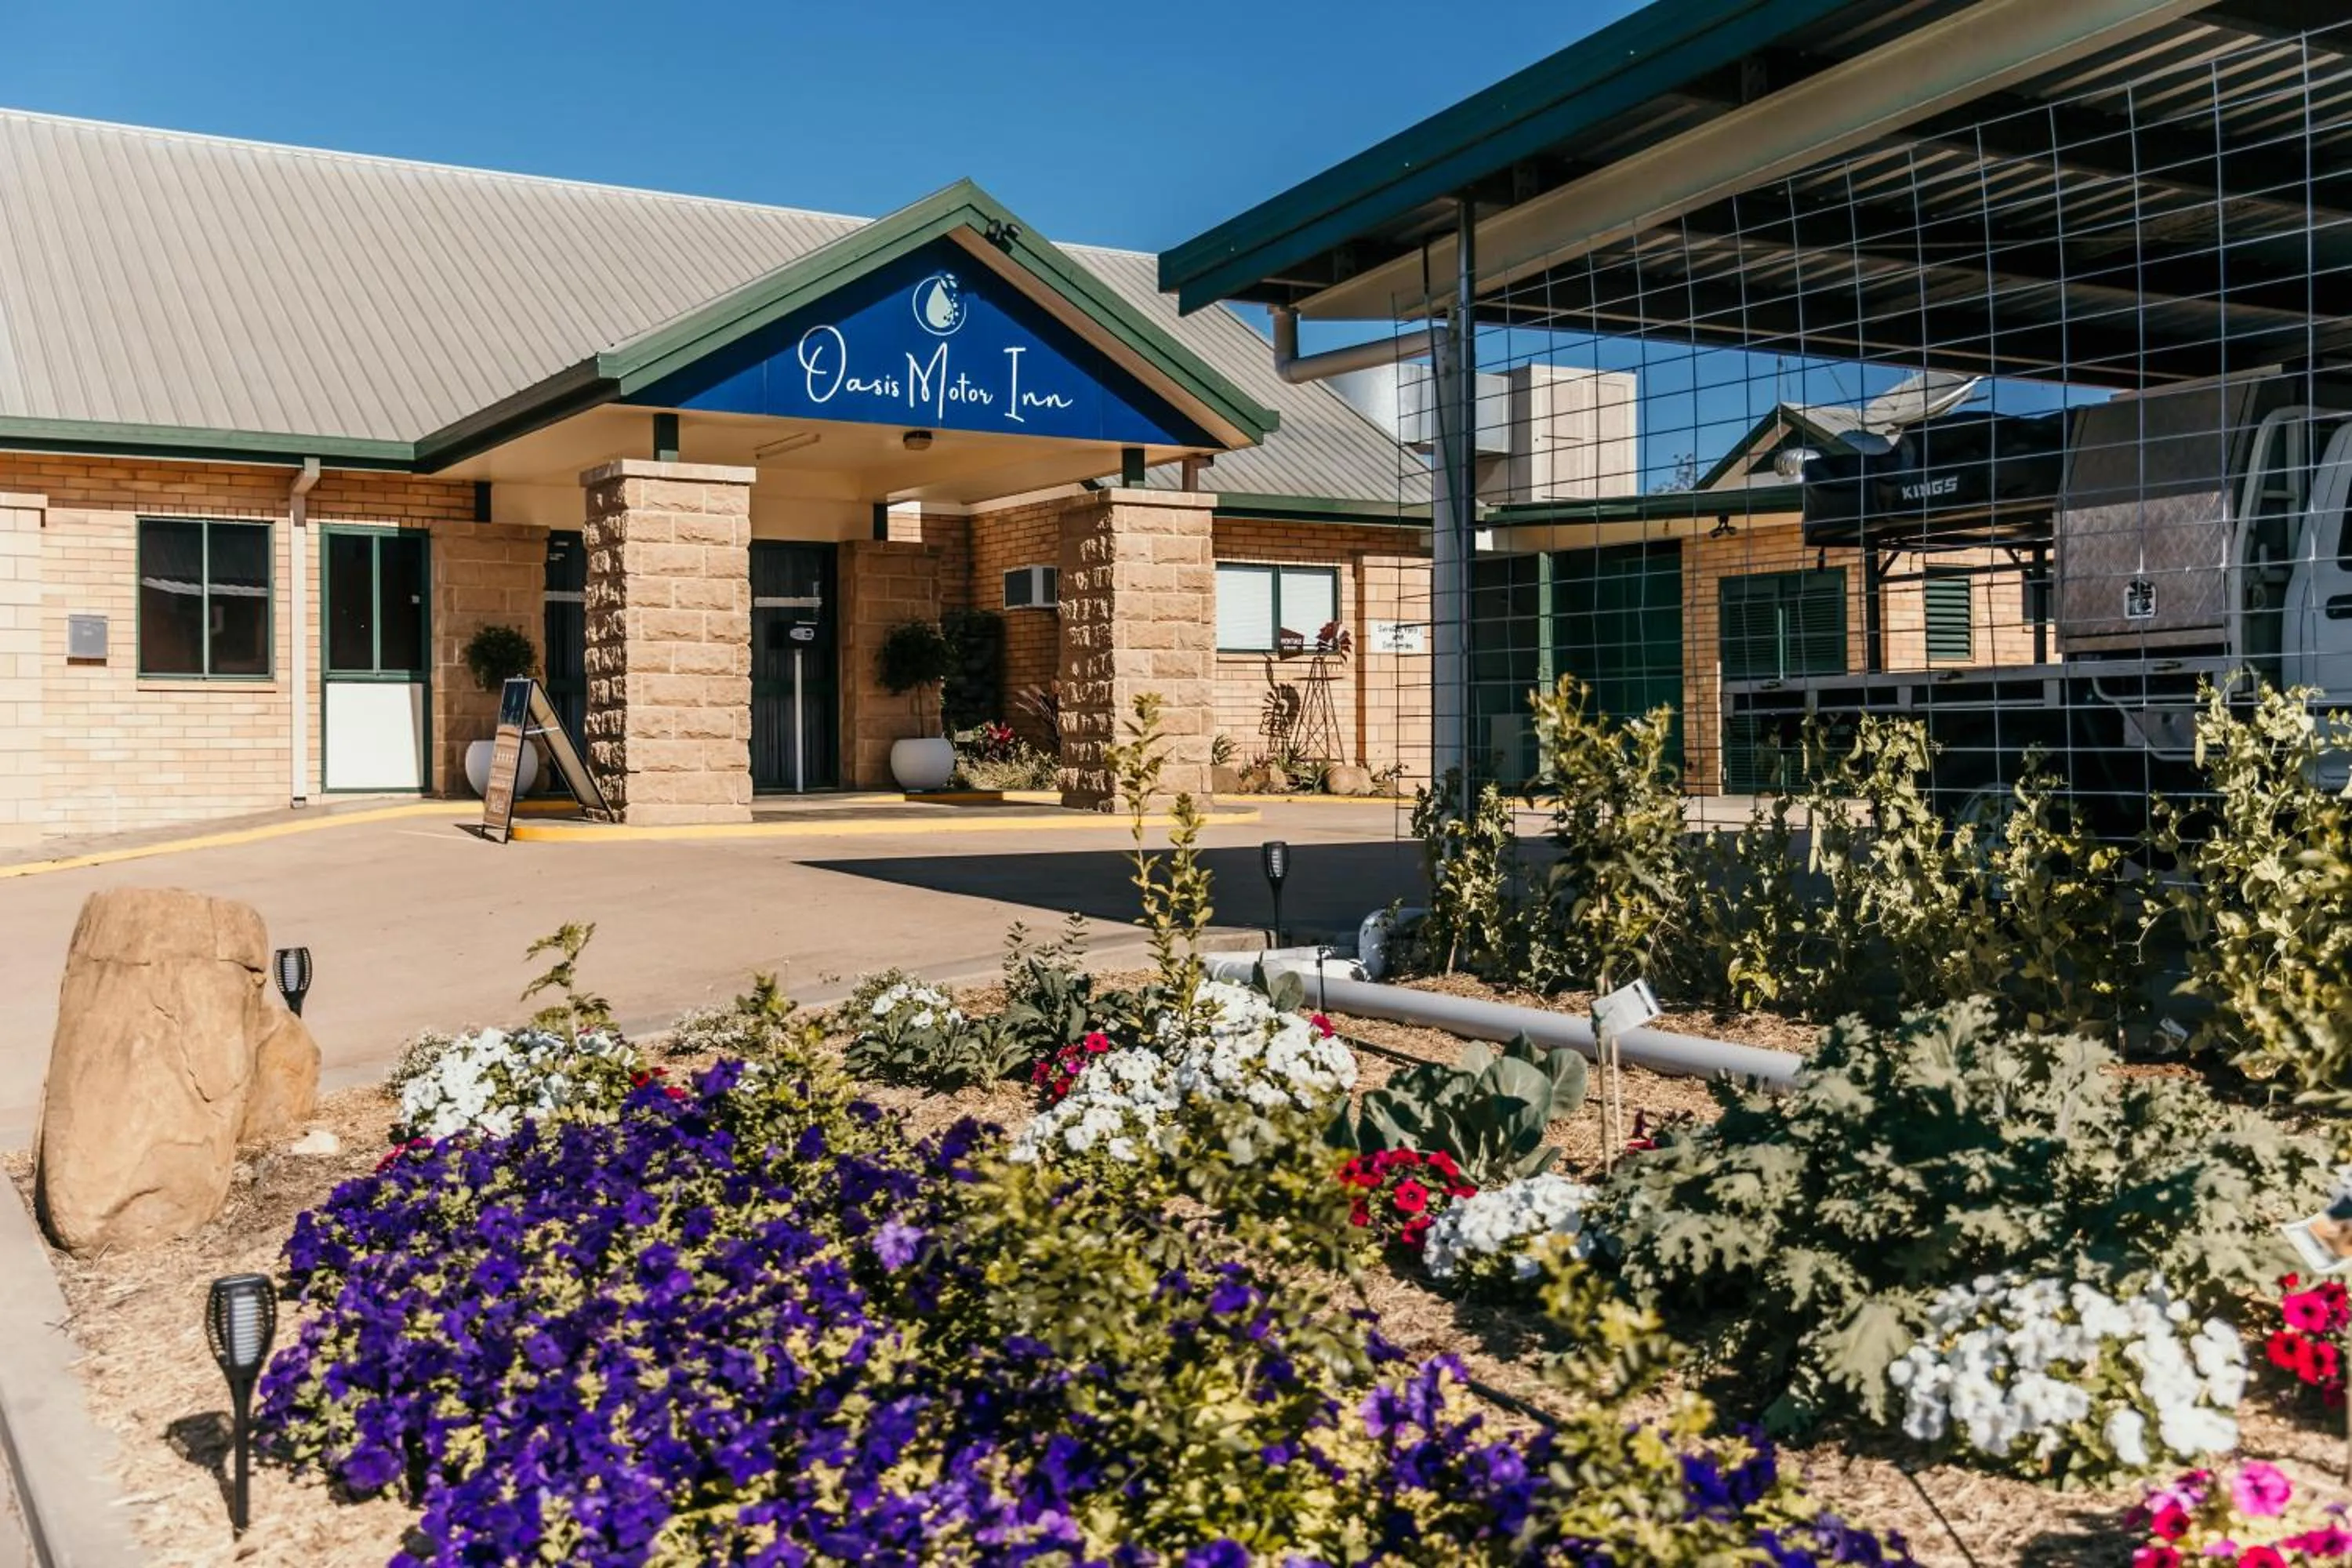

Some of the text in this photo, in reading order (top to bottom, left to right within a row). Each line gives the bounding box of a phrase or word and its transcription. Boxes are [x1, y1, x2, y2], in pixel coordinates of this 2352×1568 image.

[798, 325, 1073, 423] Oasis Motor Inn
[1902, 477, 1958, 500] KINGS
